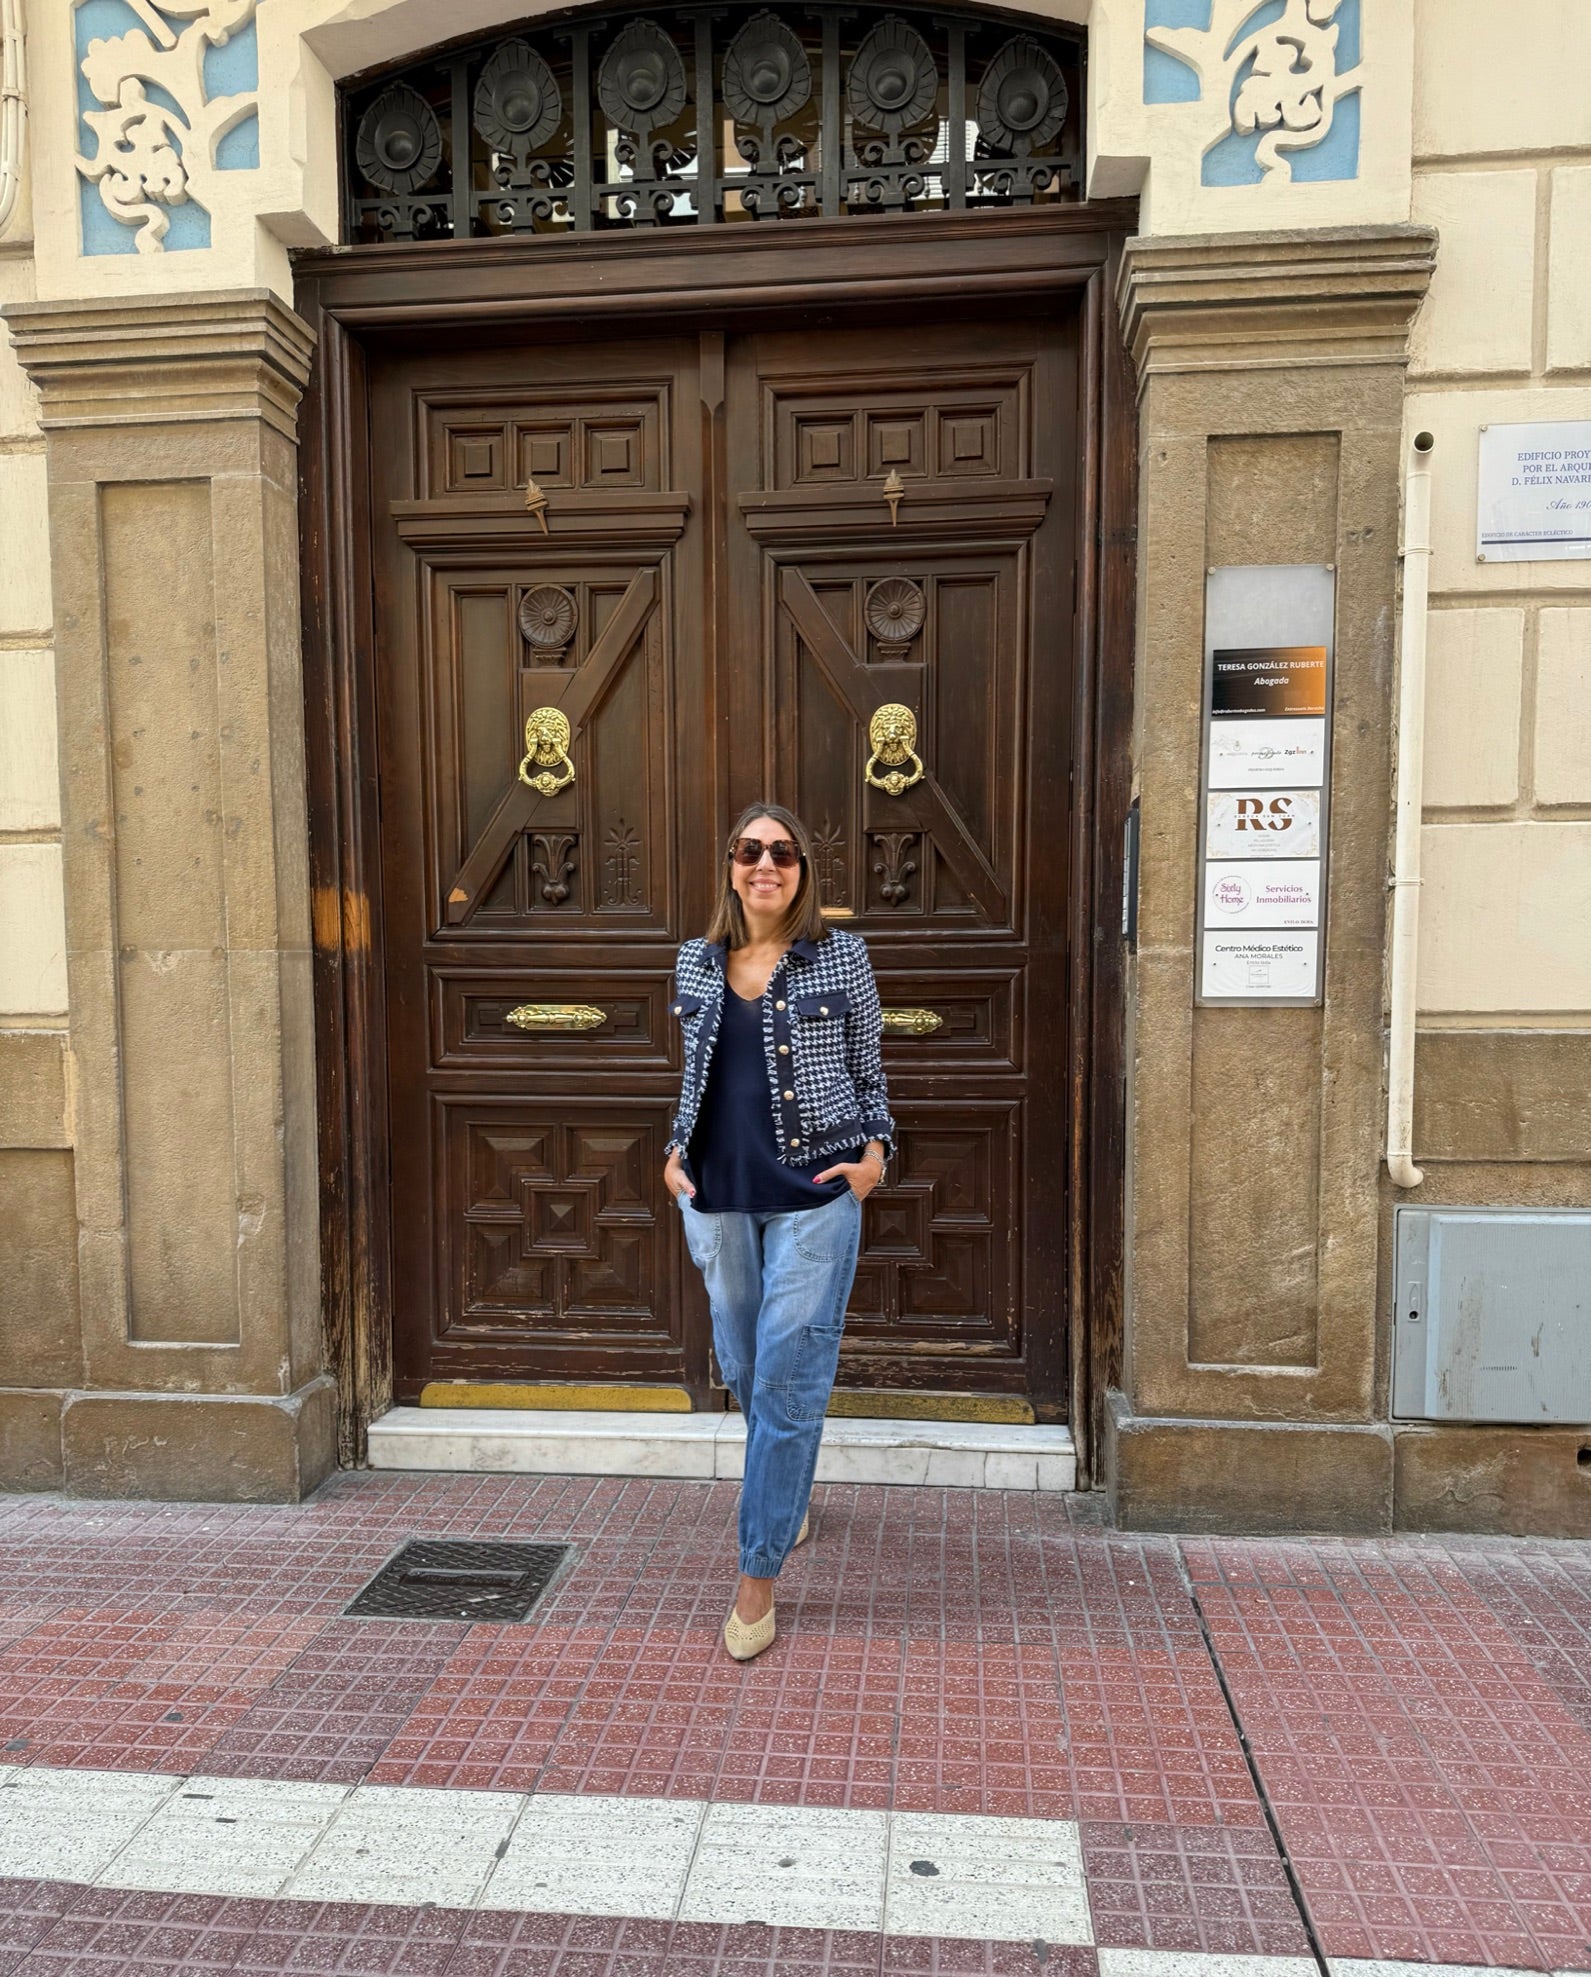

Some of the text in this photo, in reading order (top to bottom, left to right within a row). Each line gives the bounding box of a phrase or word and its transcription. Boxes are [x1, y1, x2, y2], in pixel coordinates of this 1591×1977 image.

[1517, 451, 1562, 461] EDIFICIO
[1523, 464, 1543, 473] POR
[1545, 464, 1558, 473] EL
[1511, 477, 1521, 486] D.
[1524, 475, 1553, 485] FÉLIX
[1546, 498, 1572, 510] Año
[1218, 660, 1325, 671] TERESA GONZÁLEZ RUBERTE
[1234, 797, 1293, 831] RS
[1265, 884, 1304, 893] Servicios
[1256, 896, 1312, 904] Inmobiliarios
[1215, 944, 1303, 952] Centro Médico Estético
